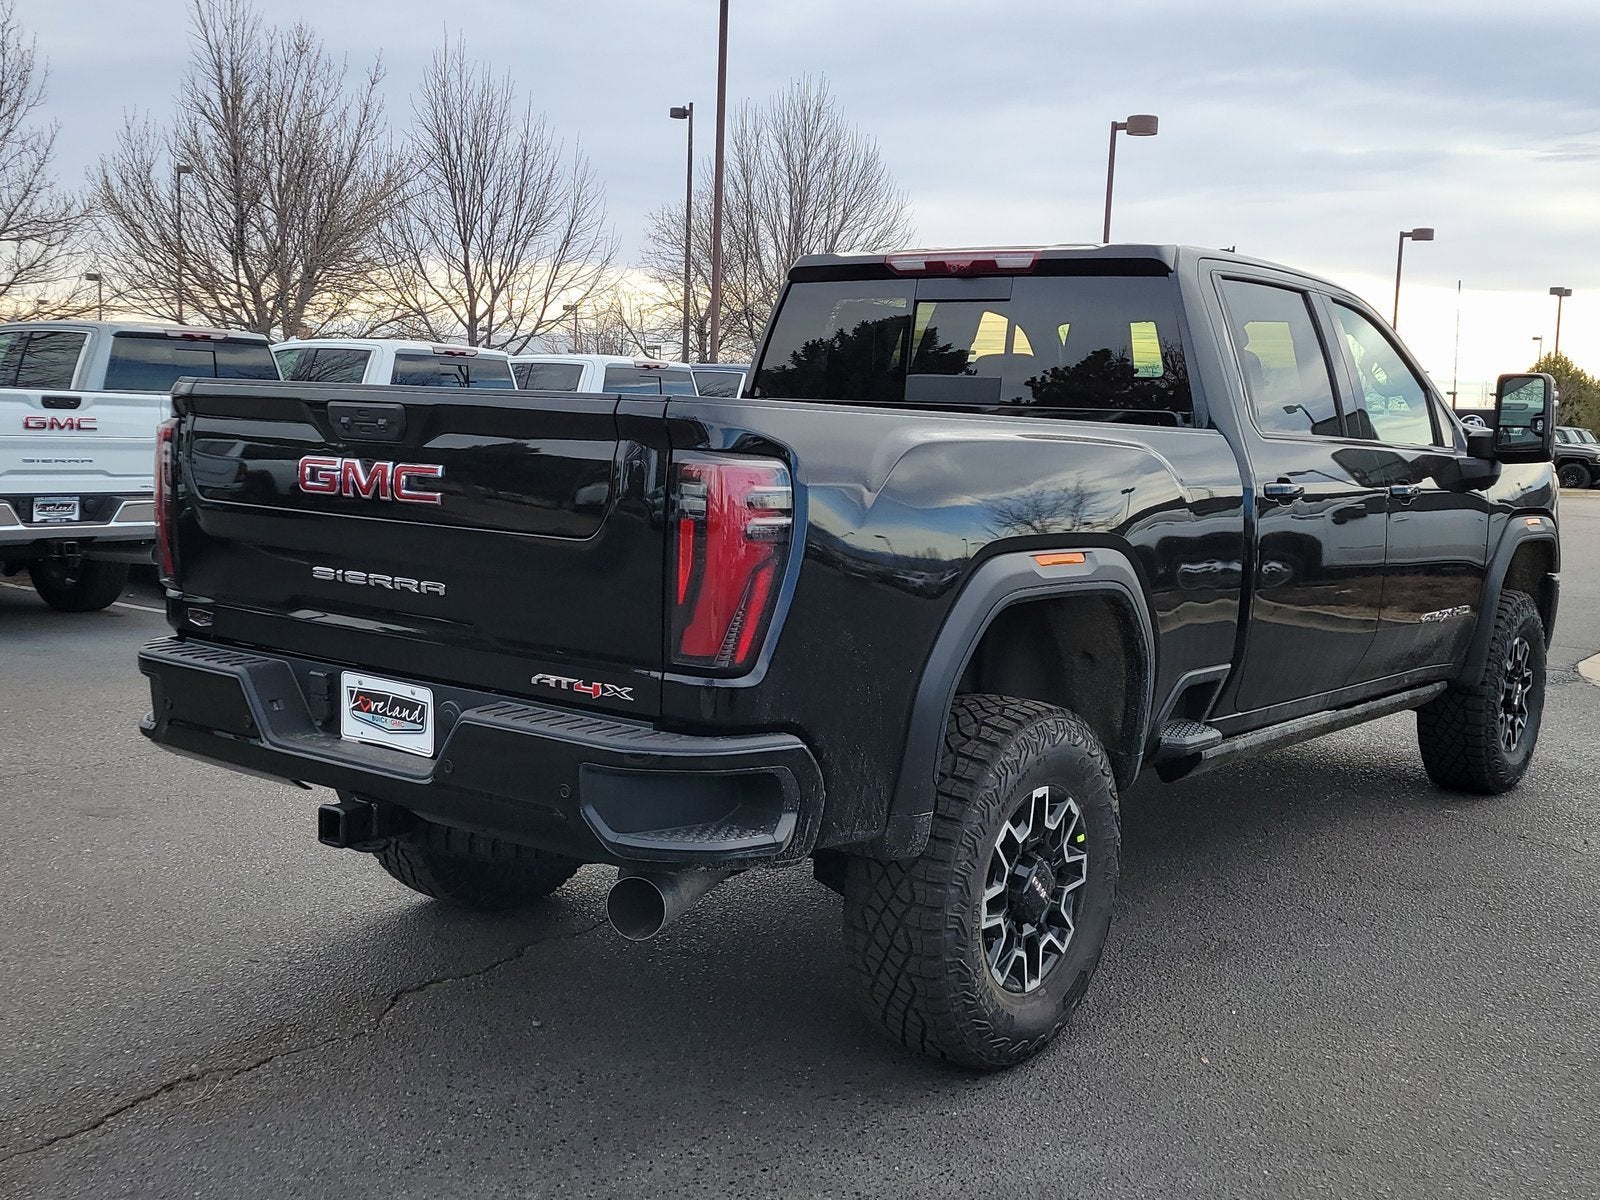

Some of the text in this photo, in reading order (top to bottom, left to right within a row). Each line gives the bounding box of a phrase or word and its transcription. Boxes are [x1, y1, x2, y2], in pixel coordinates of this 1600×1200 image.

[23, 416, 98, 431] GMC
[298, 455, 445, 505] GMC
[312, 566, 446, 596] SIERRA
[530, 673, 634, 701] AT4X
[349, 687, 424, 723] Loveland
[371, 715, 405, 728] BUICK GMC
